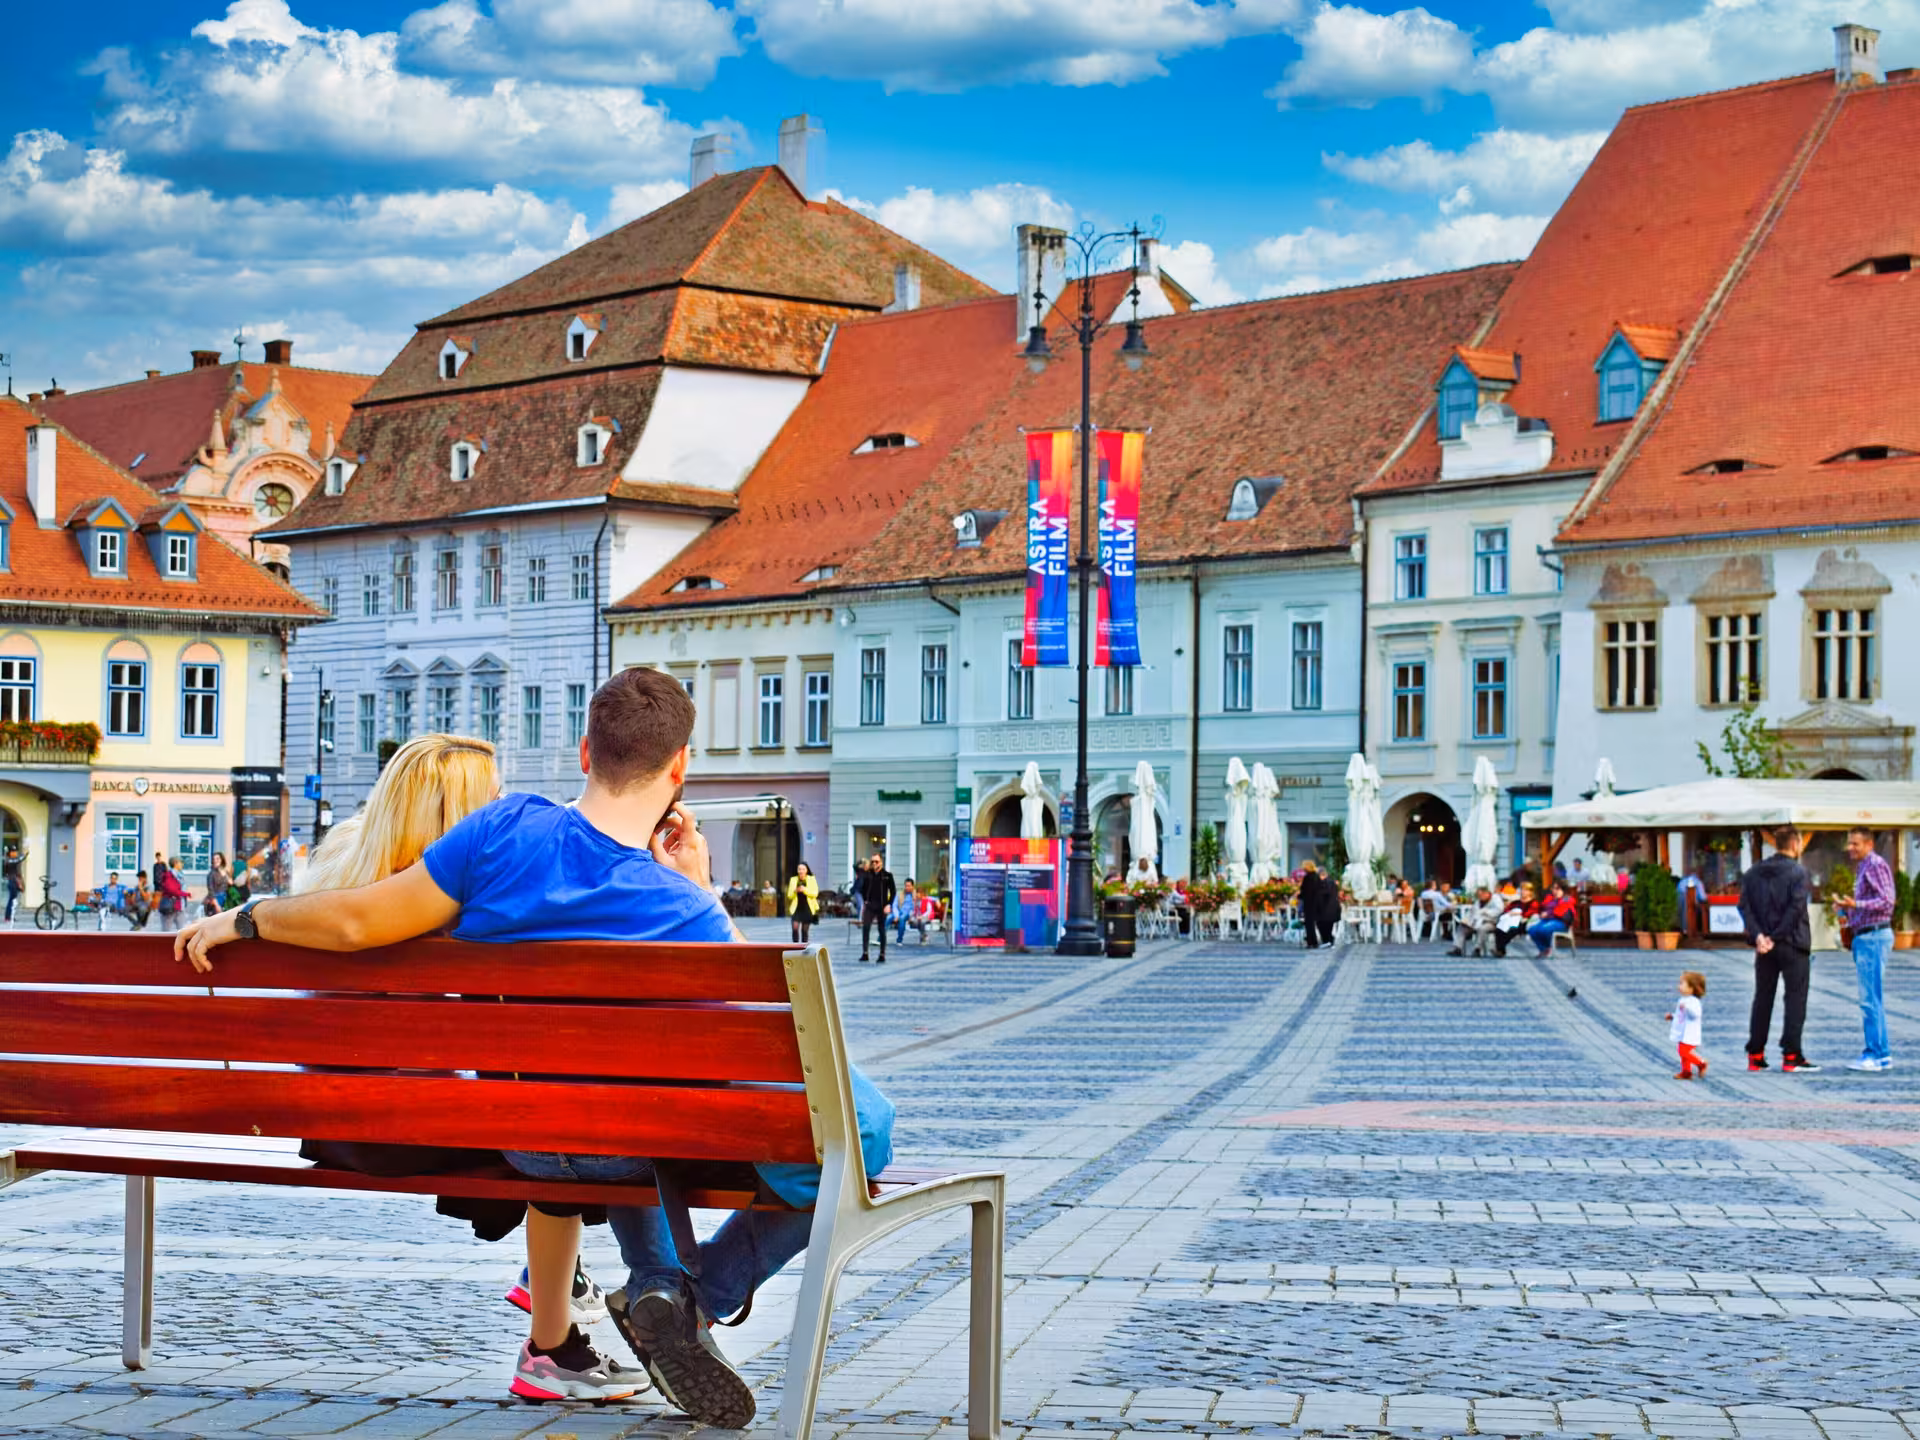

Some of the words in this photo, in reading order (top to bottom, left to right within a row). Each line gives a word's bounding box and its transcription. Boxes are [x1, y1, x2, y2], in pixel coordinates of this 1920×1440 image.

[1028, 498, 1048, 575] ASTRA
[1048, 517, 1068, 576] FILM
[1099, 499, 1116, 576] ASTRA
[1115, 519, 1135, 577] FILM
[93, 781, 131, 792] BANCA
[153, 782, 234, 795] TRANSILVANIA
